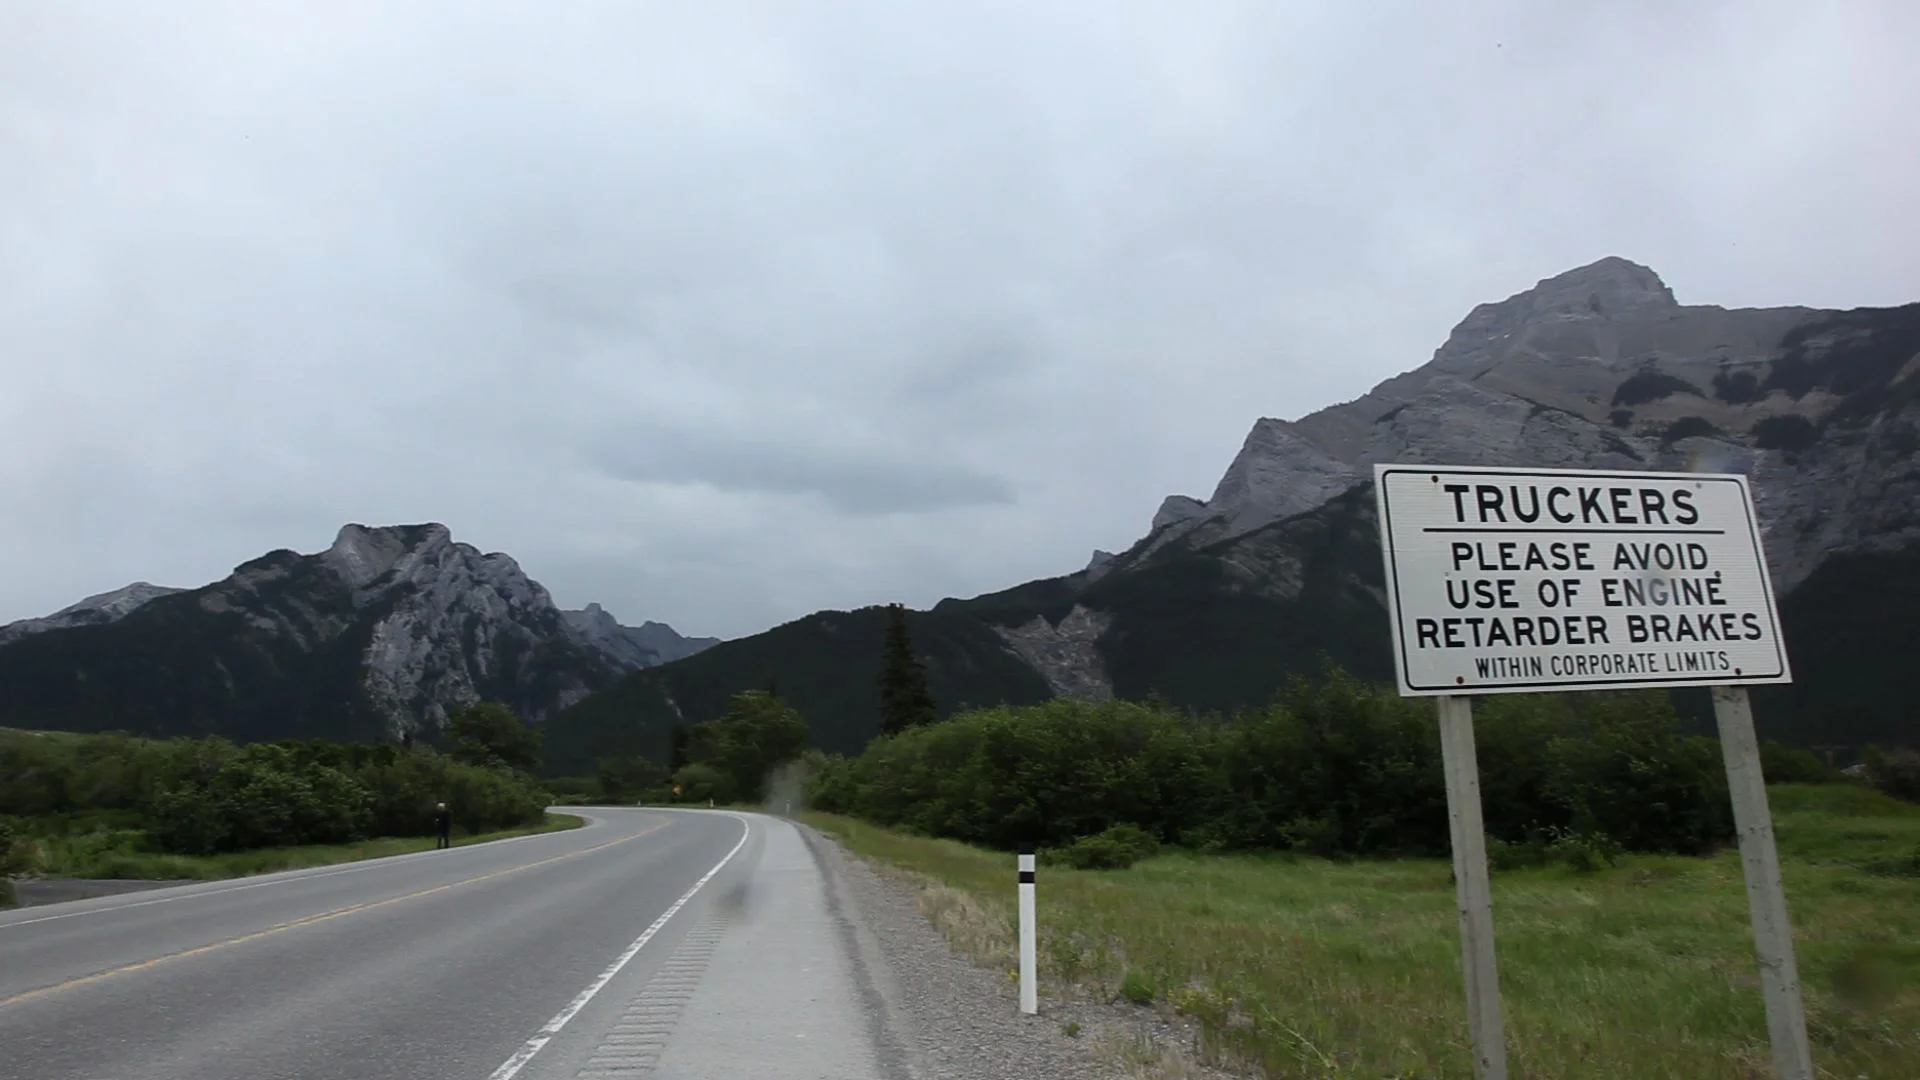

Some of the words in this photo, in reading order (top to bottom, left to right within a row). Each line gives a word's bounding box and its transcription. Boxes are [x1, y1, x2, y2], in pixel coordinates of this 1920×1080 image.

[1444, 485, 1699, 524] TRUCKERS
[1452, 542, 1595, 571] PLEASE
[1614, 543, 1708, 570] AVOID
[1446, 579, 1518, 609] USE
[1539, 579, 1580, 607] OF
[1603, 578, 1726, 607] ENGINE
[1416, 615, 1609, 648] RETARDER
[1628, 613, 1762, 643] BRAKES
[1476, 655, 1542, 678] WITHIN
[1551, 653, 1657, 676] CORPORATE
[1665, 651, 1730, 671] LIMITS
